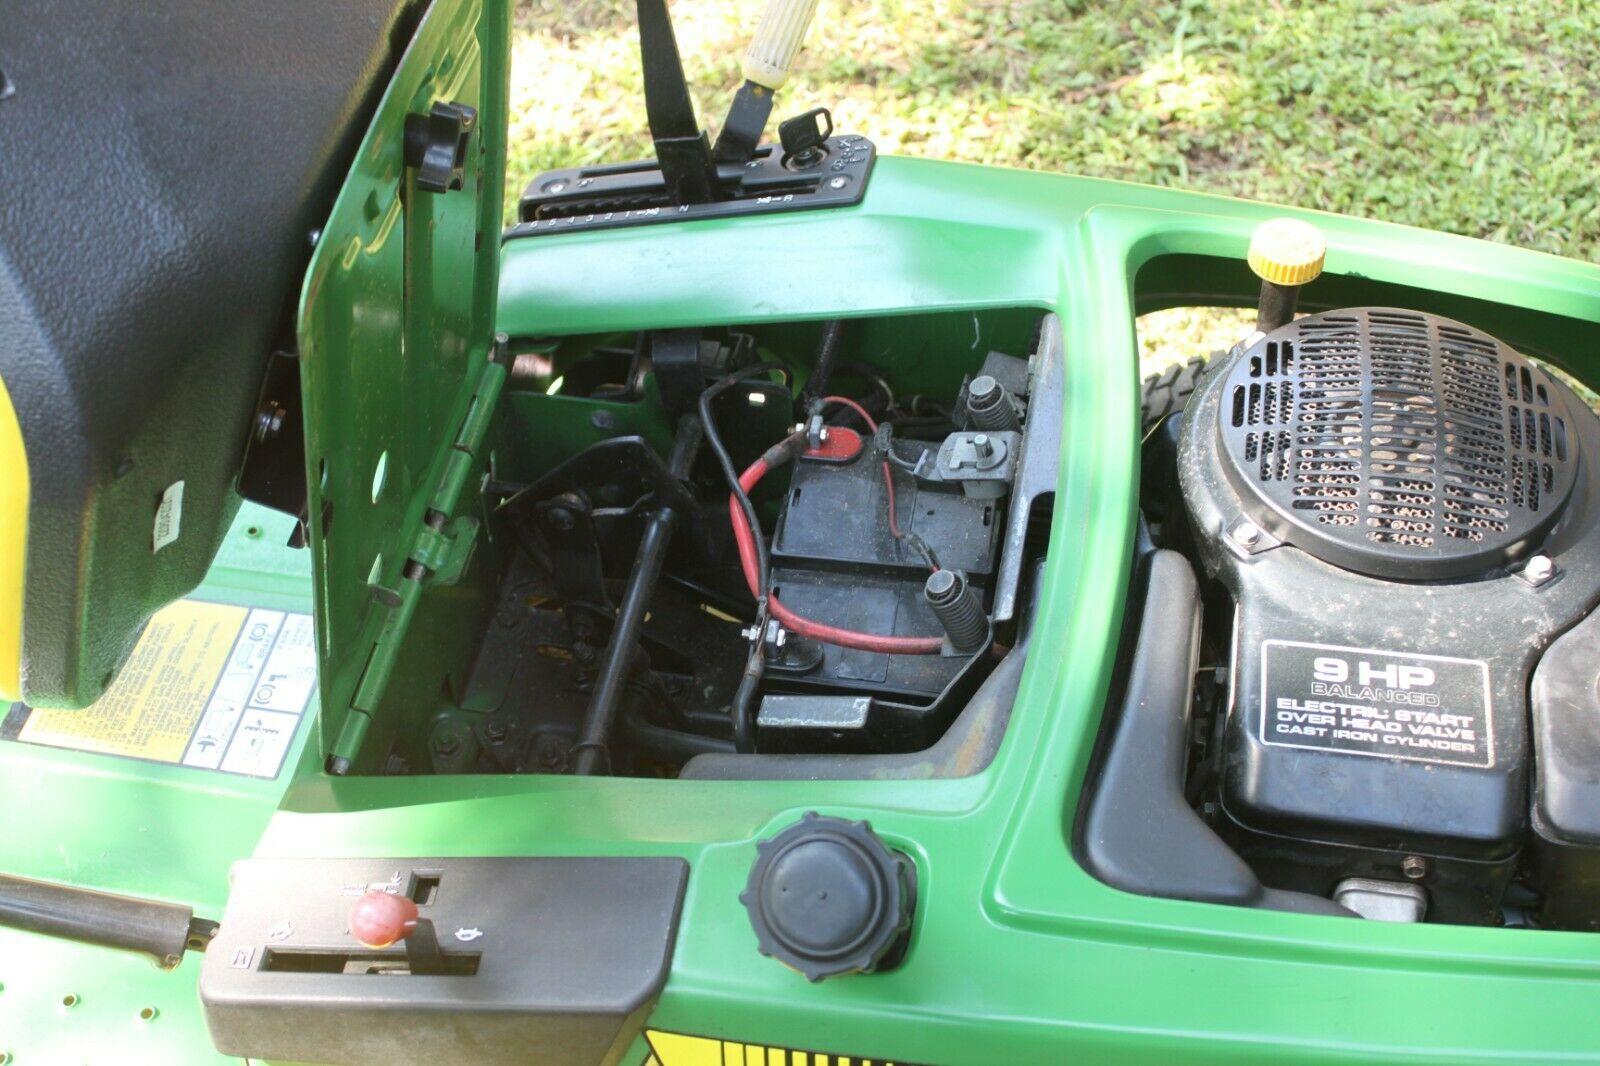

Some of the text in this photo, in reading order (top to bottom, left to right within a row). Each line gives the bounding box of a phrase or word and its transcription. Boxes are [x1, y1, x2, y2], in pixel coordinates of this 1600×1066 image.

[678, 204, 689, 212] N
[1312, 656, 1436, 690] 9 HP
[1311, 681, 1440, 707] BALANCED
[1277, 711, 1476, 741] OVER HEAD VALVE
[1394, 709, 1474, 728] START
[1276, 723, 1476, 752] CAST IRON CYLINDER
